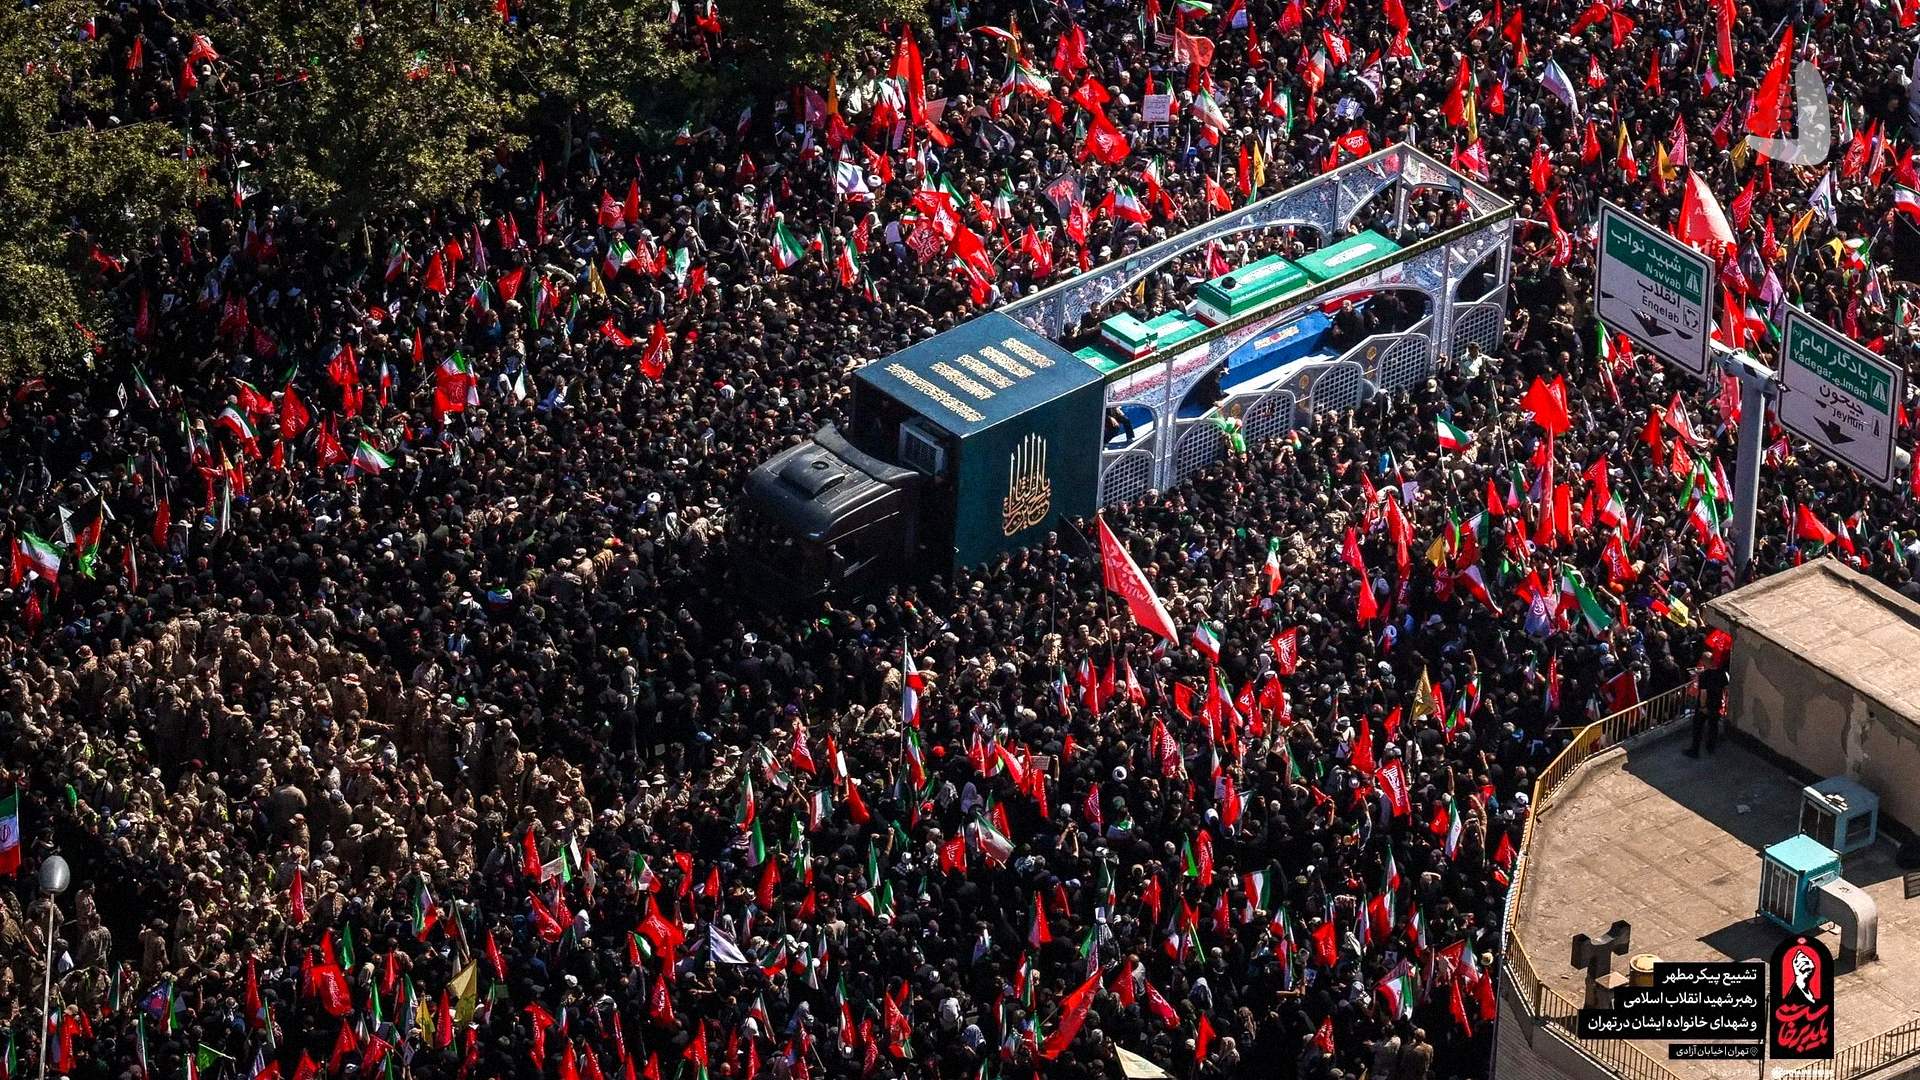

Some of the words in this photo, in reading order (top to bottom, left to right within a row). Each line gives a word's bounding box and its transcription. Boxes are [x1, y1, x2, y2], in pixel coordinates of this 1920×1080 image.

[1611, 229, 1645, 254] نواب
[1648, 249, 1681, 272] شهید
[1637, 280, 1681, 308] انقلاب
[1642, 295, 1680, 324] Enqelab
[1800, 336, 1827, 356] امام
[1828, 352, 1868, 385] یادگار
[1820, 384, 1864, 417] جیحون
